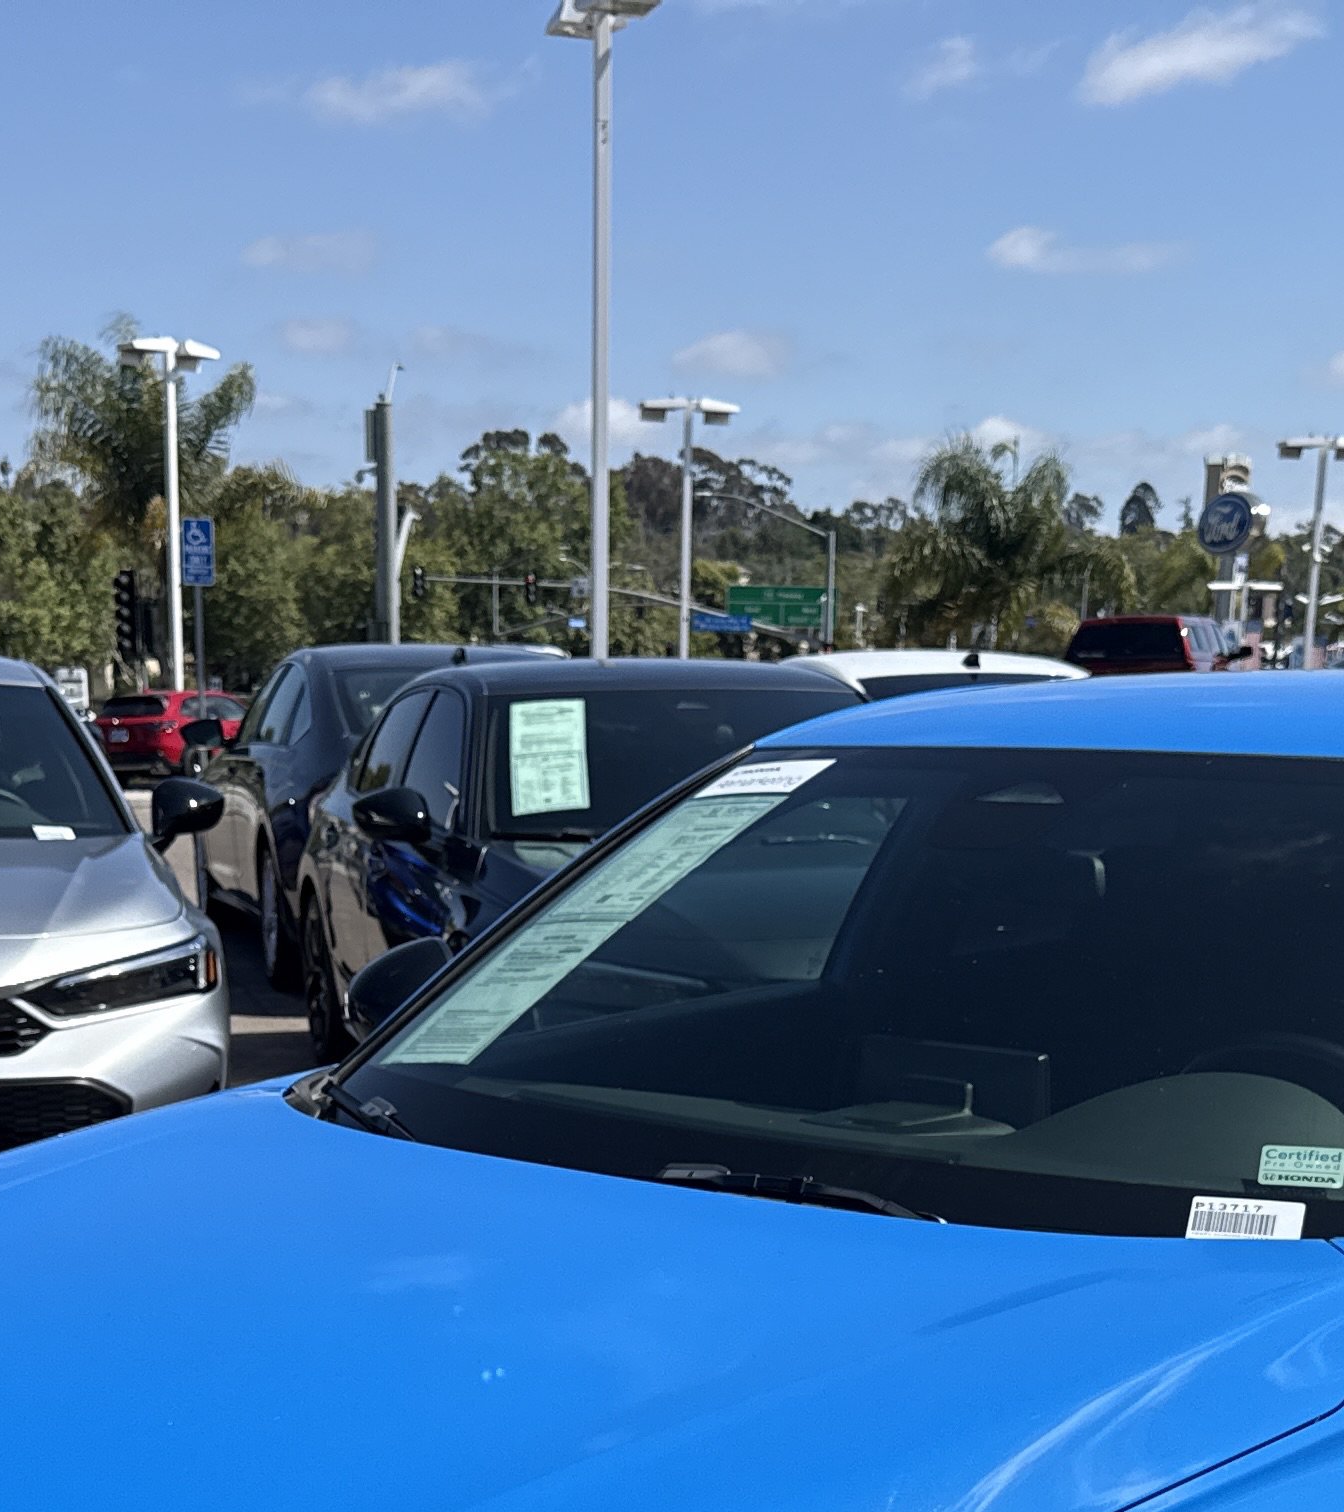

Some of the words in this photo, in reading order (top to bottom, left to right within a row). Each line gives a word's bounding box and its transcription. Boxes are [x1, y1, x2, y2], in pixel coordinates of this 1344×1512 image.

[1203, 505, 1242, 543] Ford
[1265, 1148, 1343, 1163] Certified
[1277, 1174, 1337, 1184] HONDA
